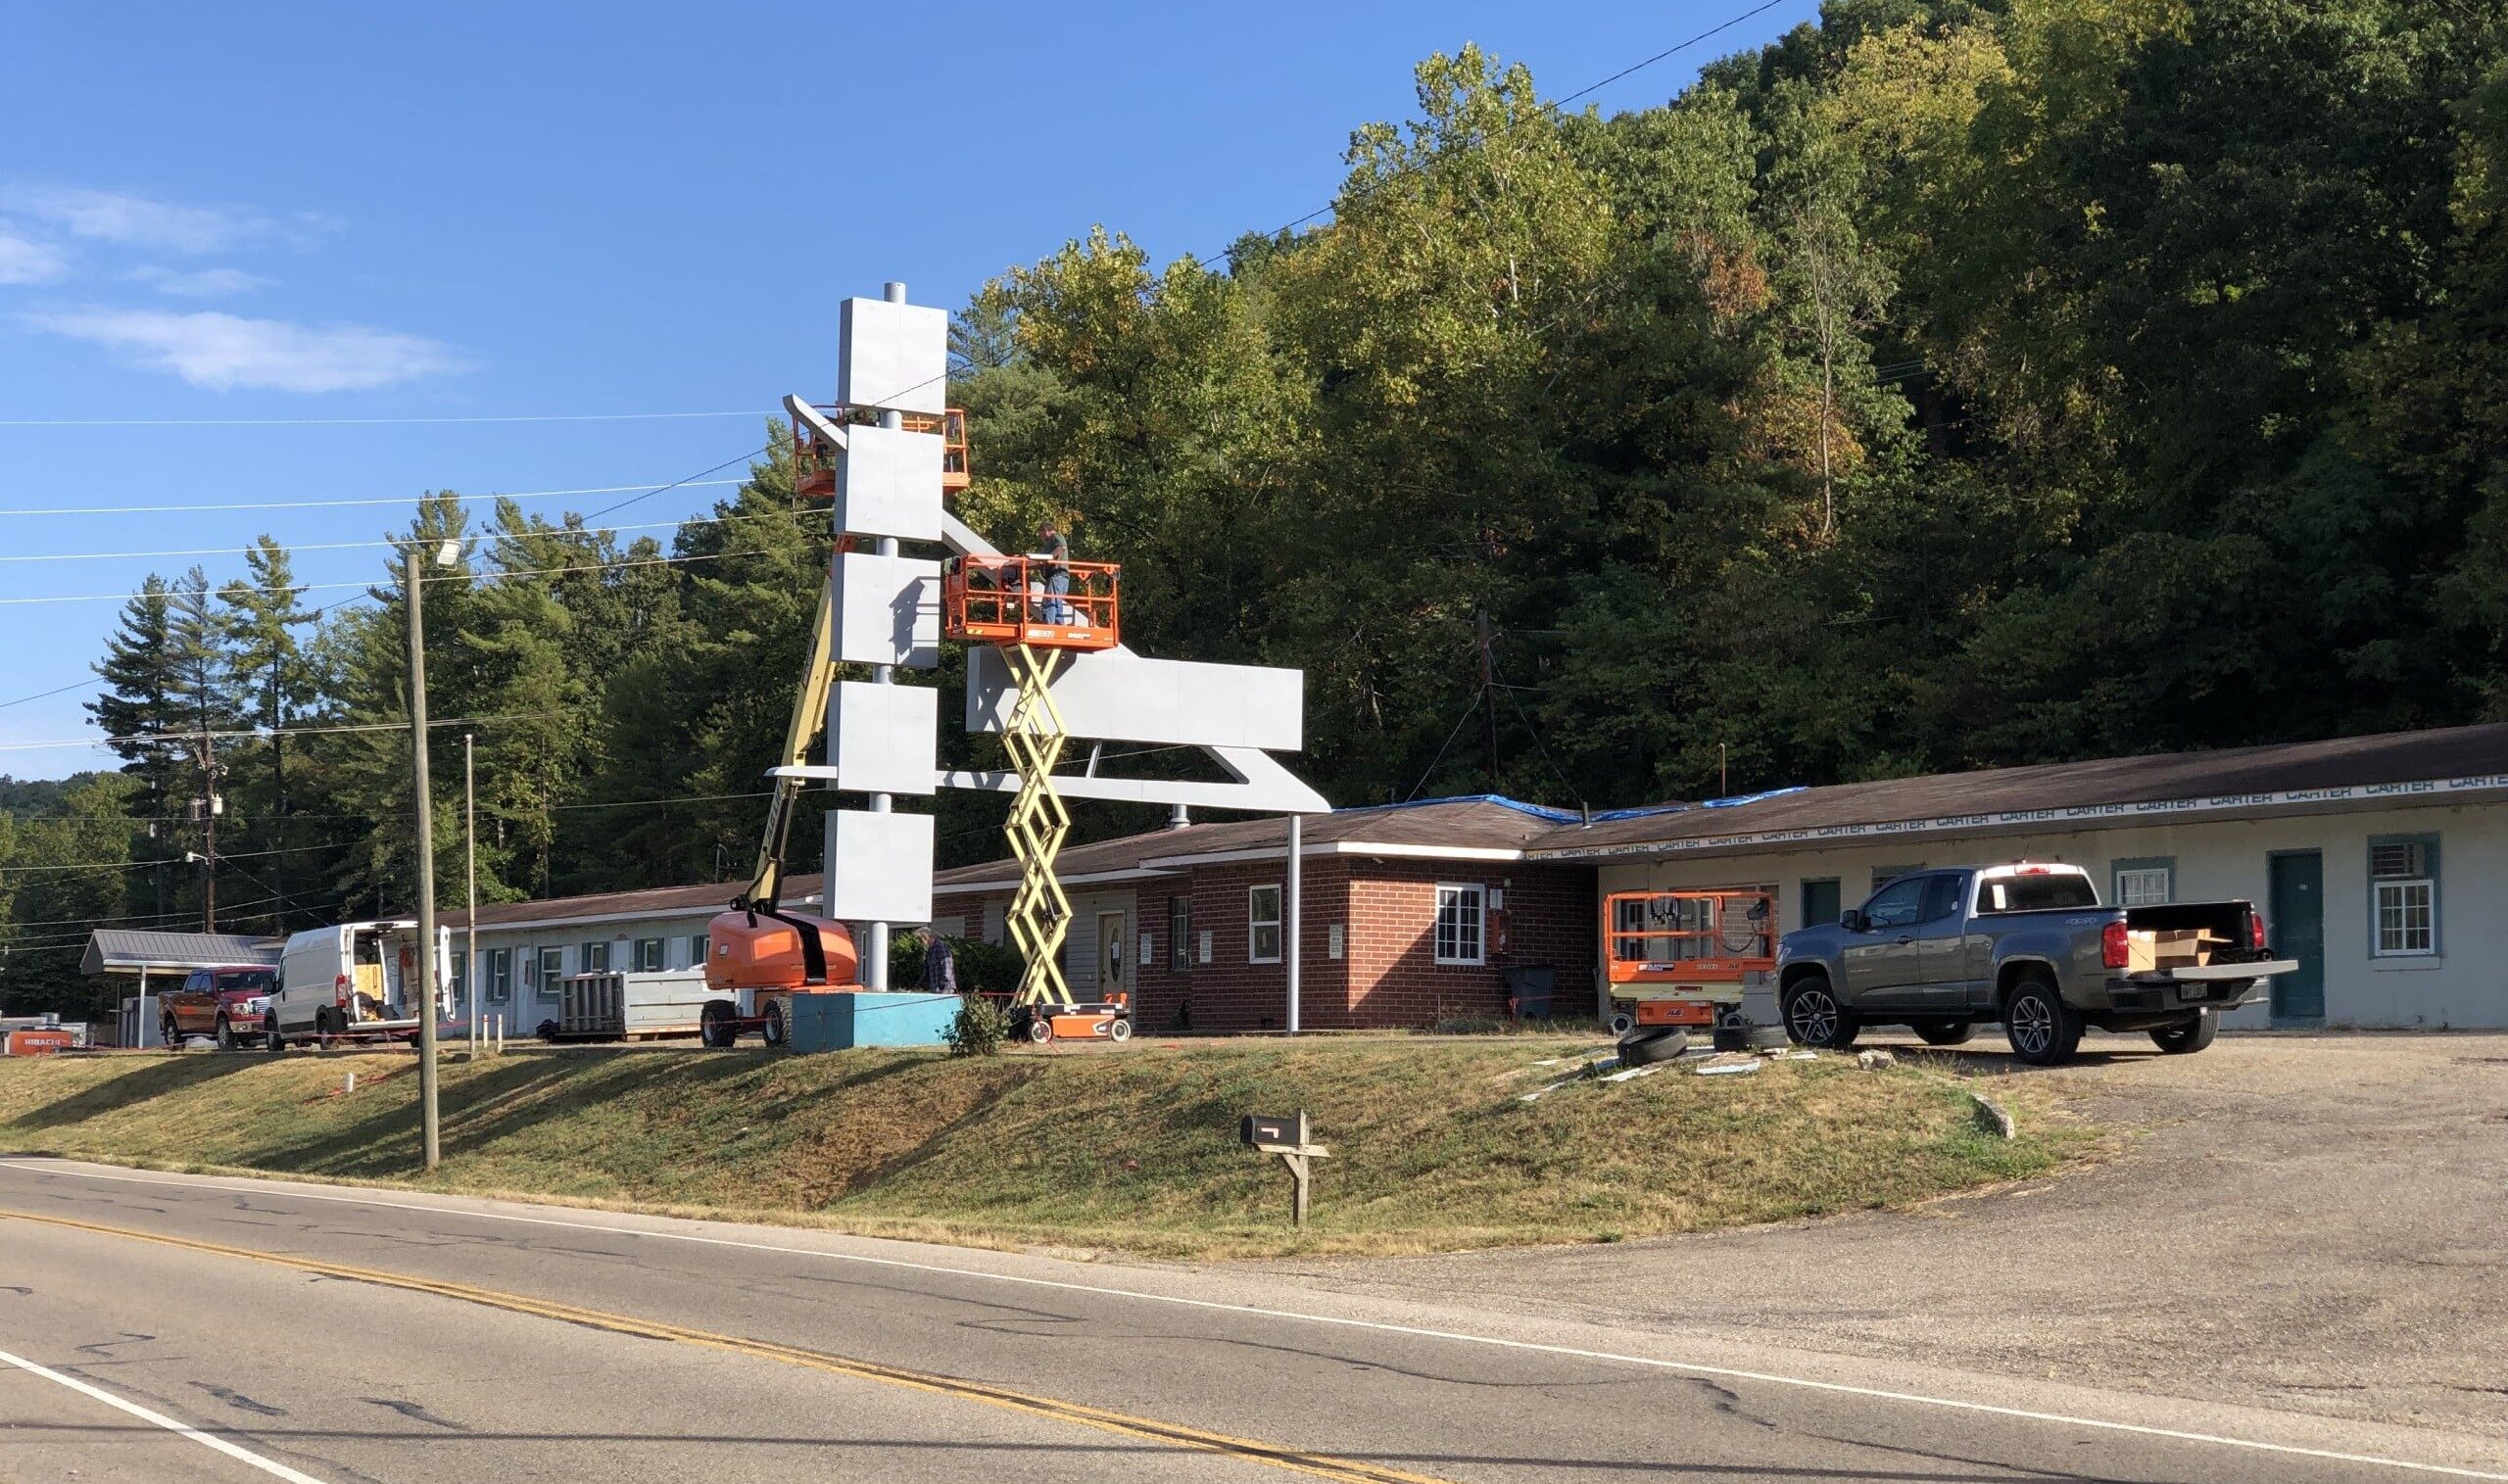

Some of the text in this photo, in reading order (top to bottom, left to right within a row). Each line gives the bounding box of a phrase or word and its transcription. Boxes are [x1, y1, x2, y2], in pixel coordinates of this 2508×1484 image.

[1936, 814, 1990, 827] CARTER
[2000, 809, 2055, 821] CARTER
[2066, 803, 2125, 816] CARTER
[2136, 799, 2196, 811] CARTER
[2365, 781, 2435, 794] CARTER
[2449, 775, 2508, 789] CARTE
